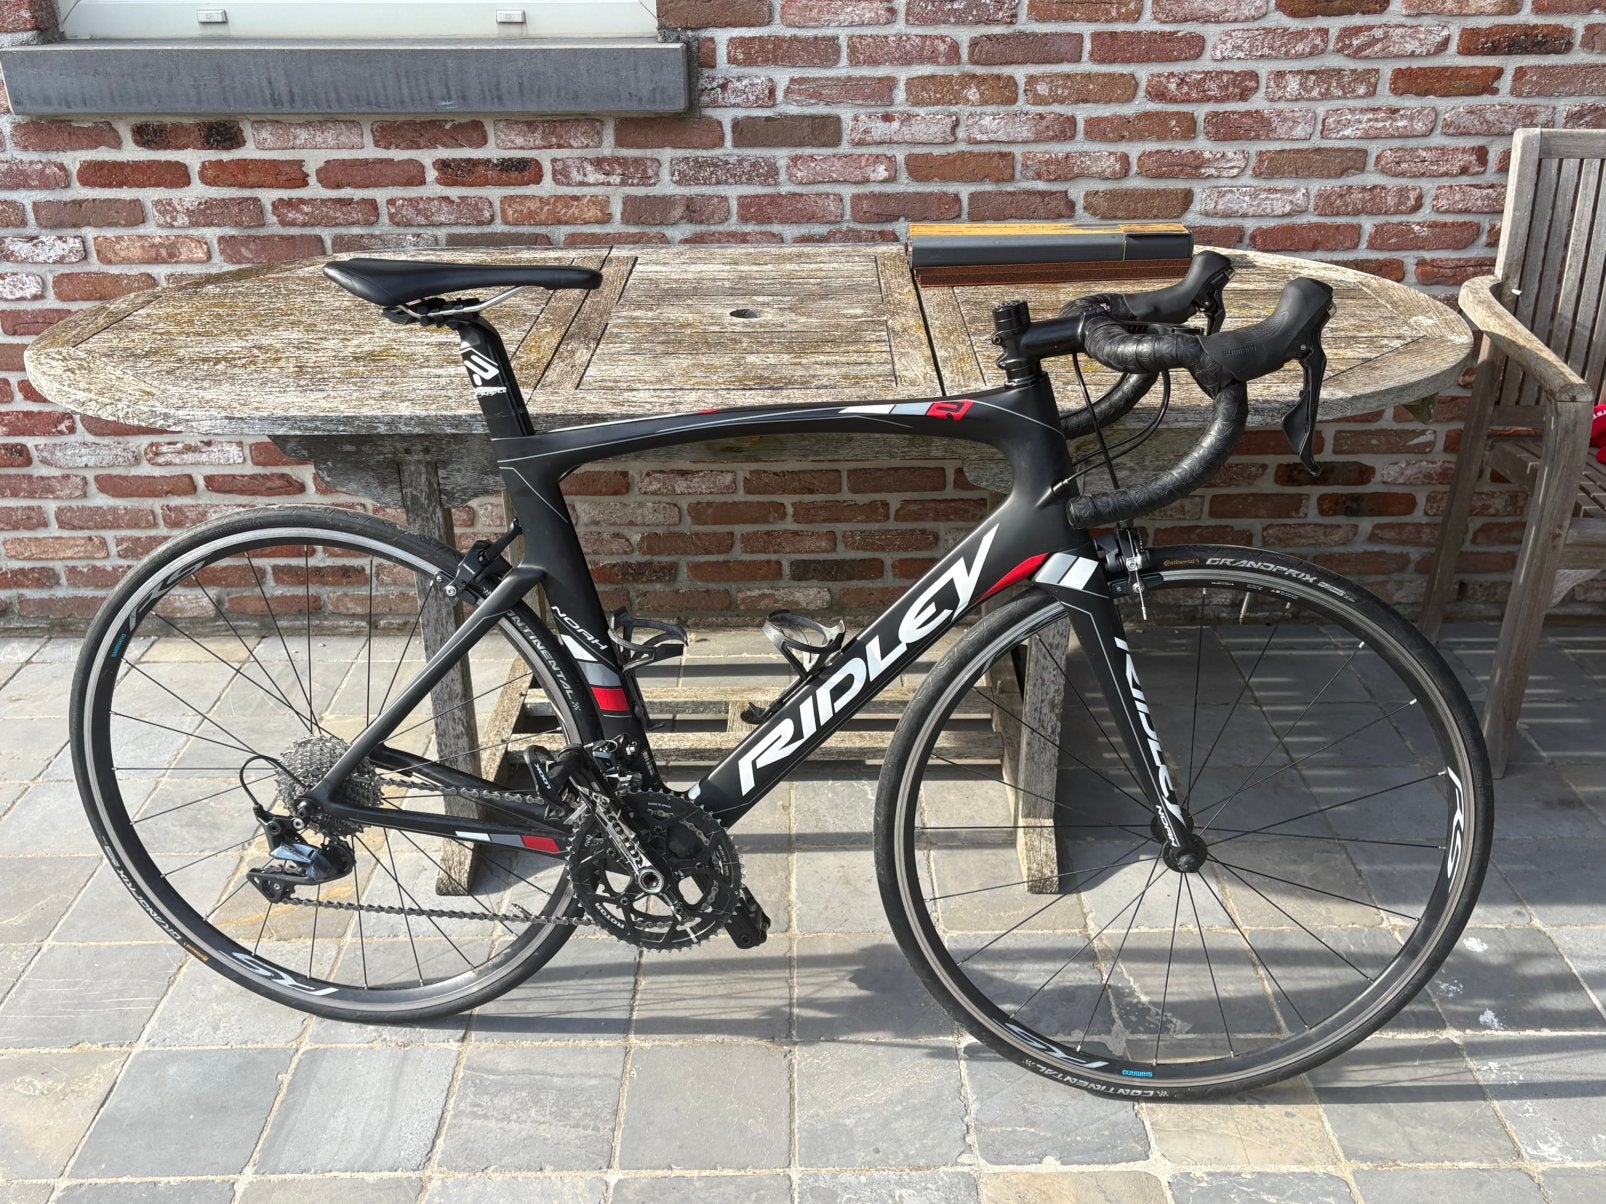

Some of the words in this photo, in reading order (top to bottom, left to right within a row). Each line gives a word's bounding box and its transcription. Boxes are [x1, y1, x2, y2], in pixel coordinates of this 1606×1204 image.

[1205, 557, 1318, 583] GRANDPRIX
[551, 606, 609, 650] NOAH
[506, 609, 575, 700] ONTINENTAL
[738, 523, 999, 796] RIDLEY
[534, 763, 552, 790] LOOK
[1155, 804, 1178, 847] NOAH
[595, 902, 625, 929] ROTOR
[1035, 1065, 1154, 1097] CONTINENTAL
[1121, 1069, 1153, 1078] SHIMANO
